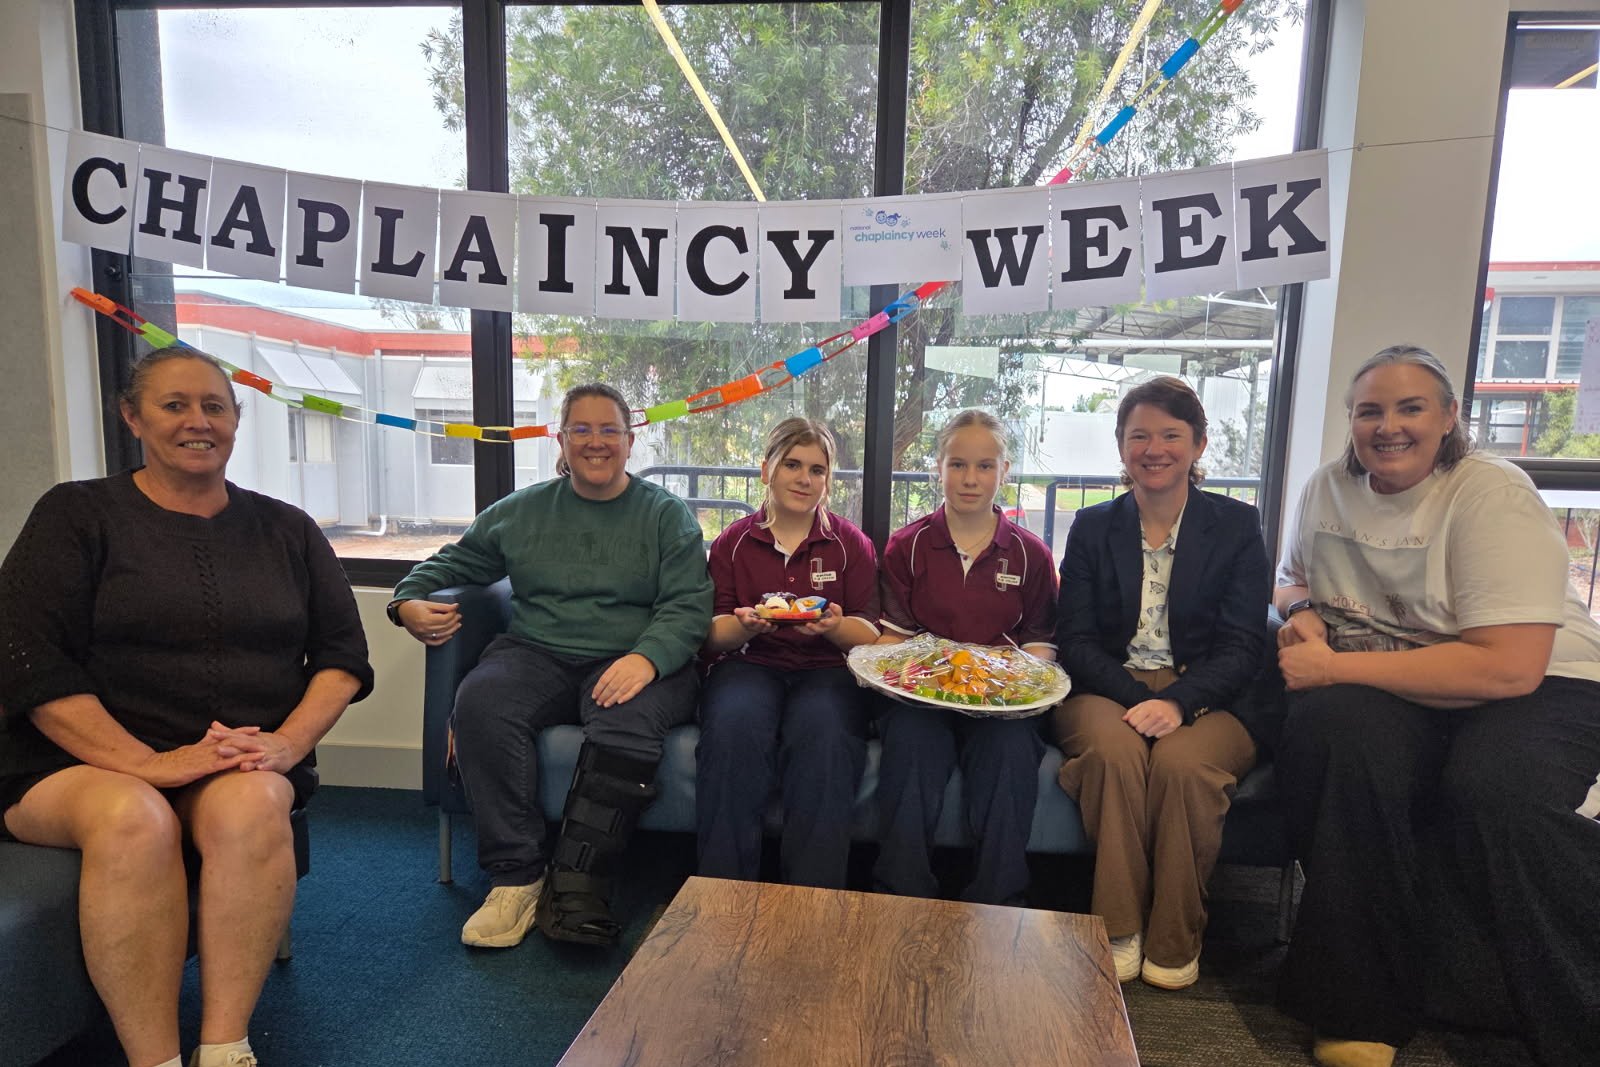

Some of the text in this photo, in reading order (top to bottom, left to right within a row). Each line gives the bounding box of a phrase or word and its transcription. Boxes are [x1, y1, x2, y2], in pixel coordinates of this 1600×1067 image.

[71, 157, 1327, 300] CHAPLAINCY WEEK
[855, 228, 946, 243] chaplaincy week
